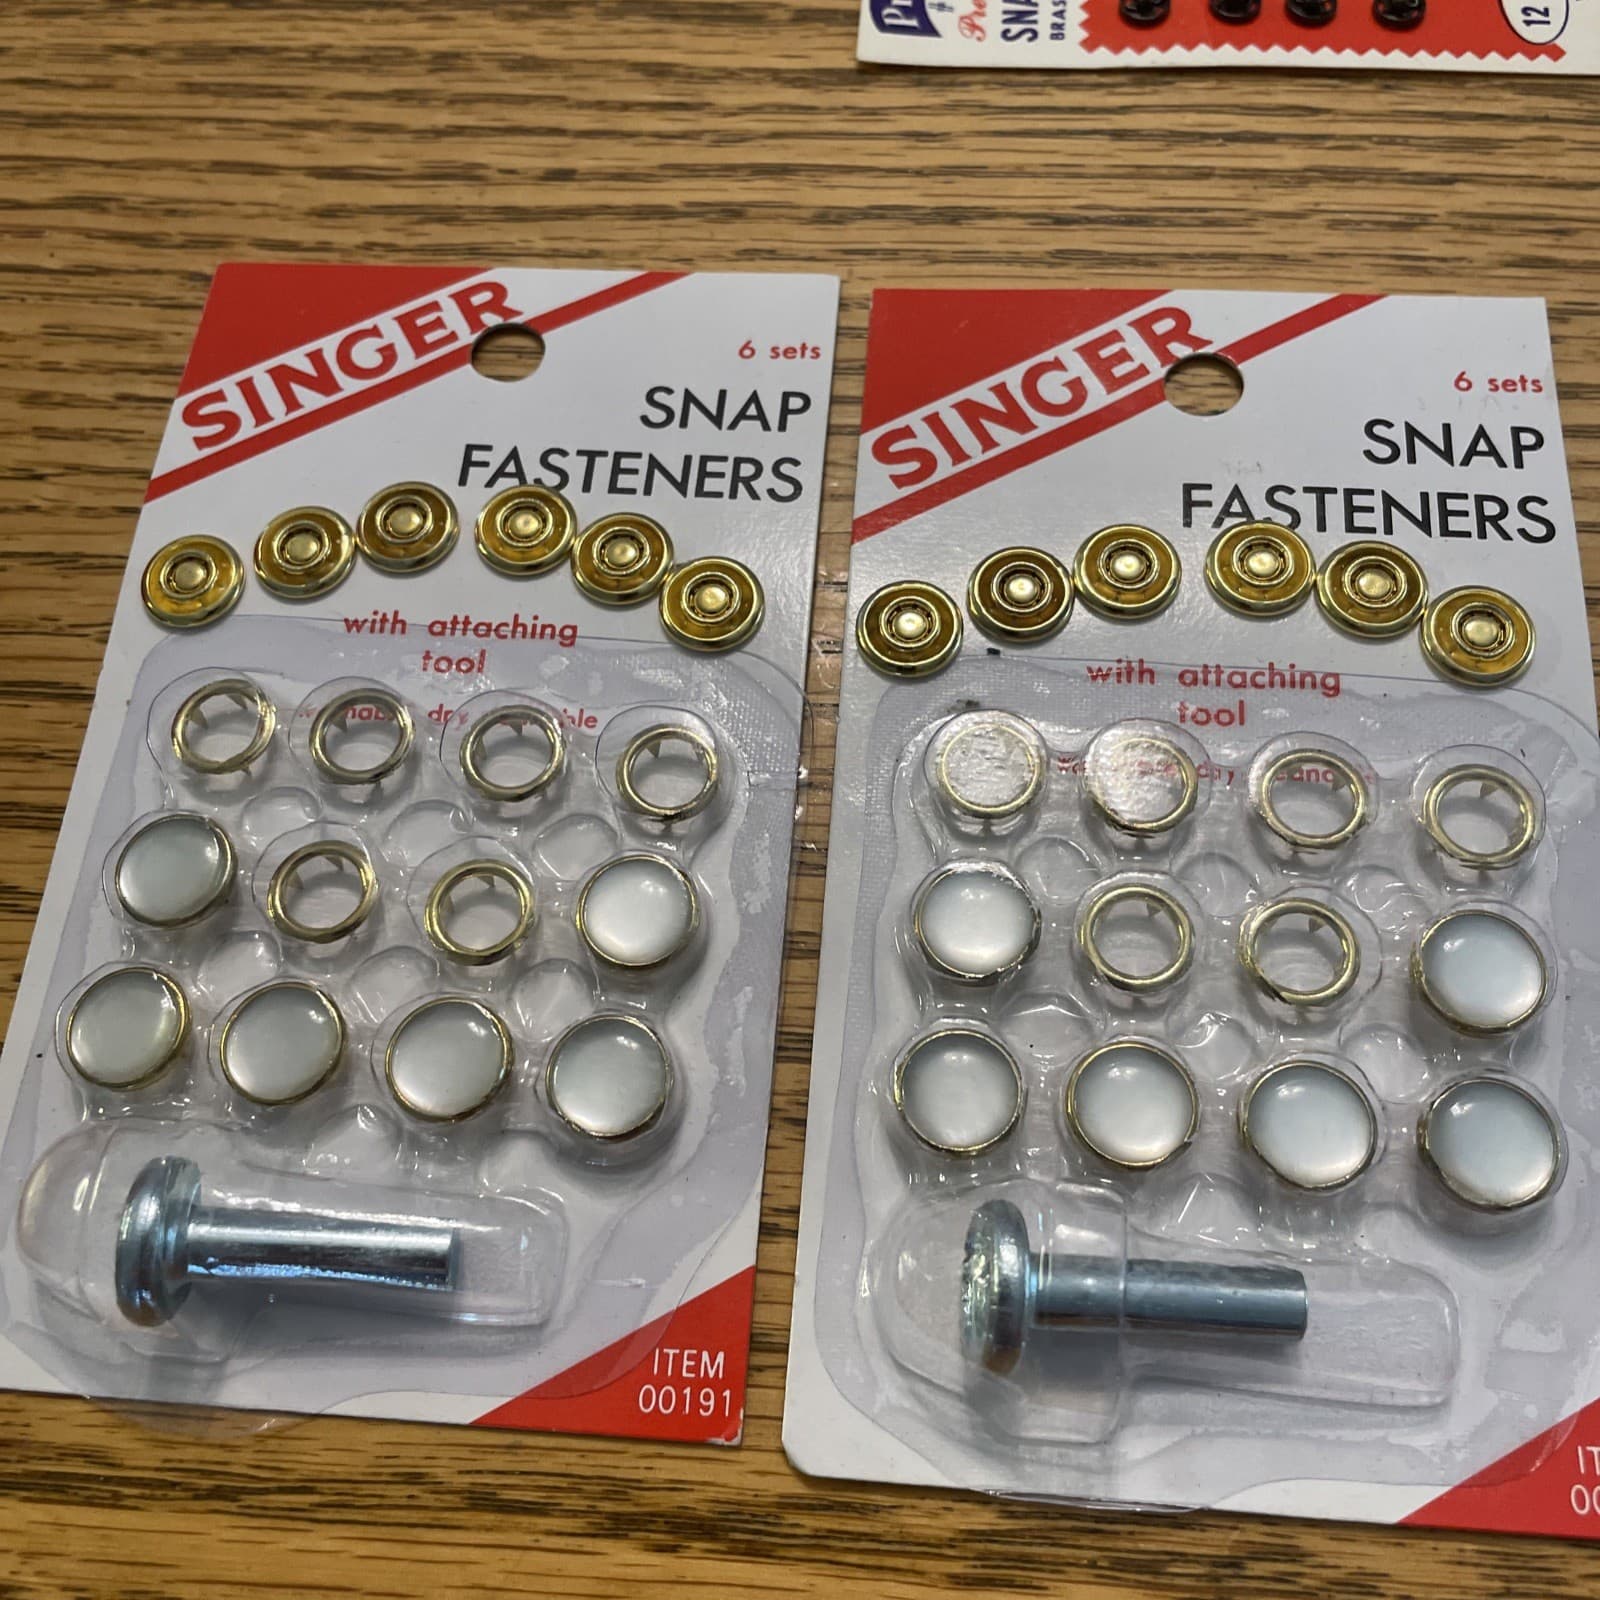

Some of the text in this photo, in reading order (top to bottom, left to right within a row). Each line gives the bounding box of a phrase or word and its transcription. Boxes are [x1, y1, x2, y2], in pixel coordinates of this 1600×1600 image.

[1521, 6, 1551, 27] 12
[181, 280, 523, 451] SINGER
[738, 340, 821, 360] 6 sets
[871, 306, 1213, 490] SINGER
[1453, 371, 1544, 393] 6 sets
[639, 386, 812, 433] SNAP
[1362, 418, 1545, 470] SNAP
[457, 443, 803, 503] FASTENERS
[1181, 482, 1557, 544] FASTENERS
[343, 610, 578, 648] with attaching
[421, 649, 487, 674] tool
[1086, 658, 1341, 698] with attaching
[1177, 699, 1246, 727] tool
[653, 1347, 726, 1379] ITEM
[638, 1384, 731, 1418] 00191
